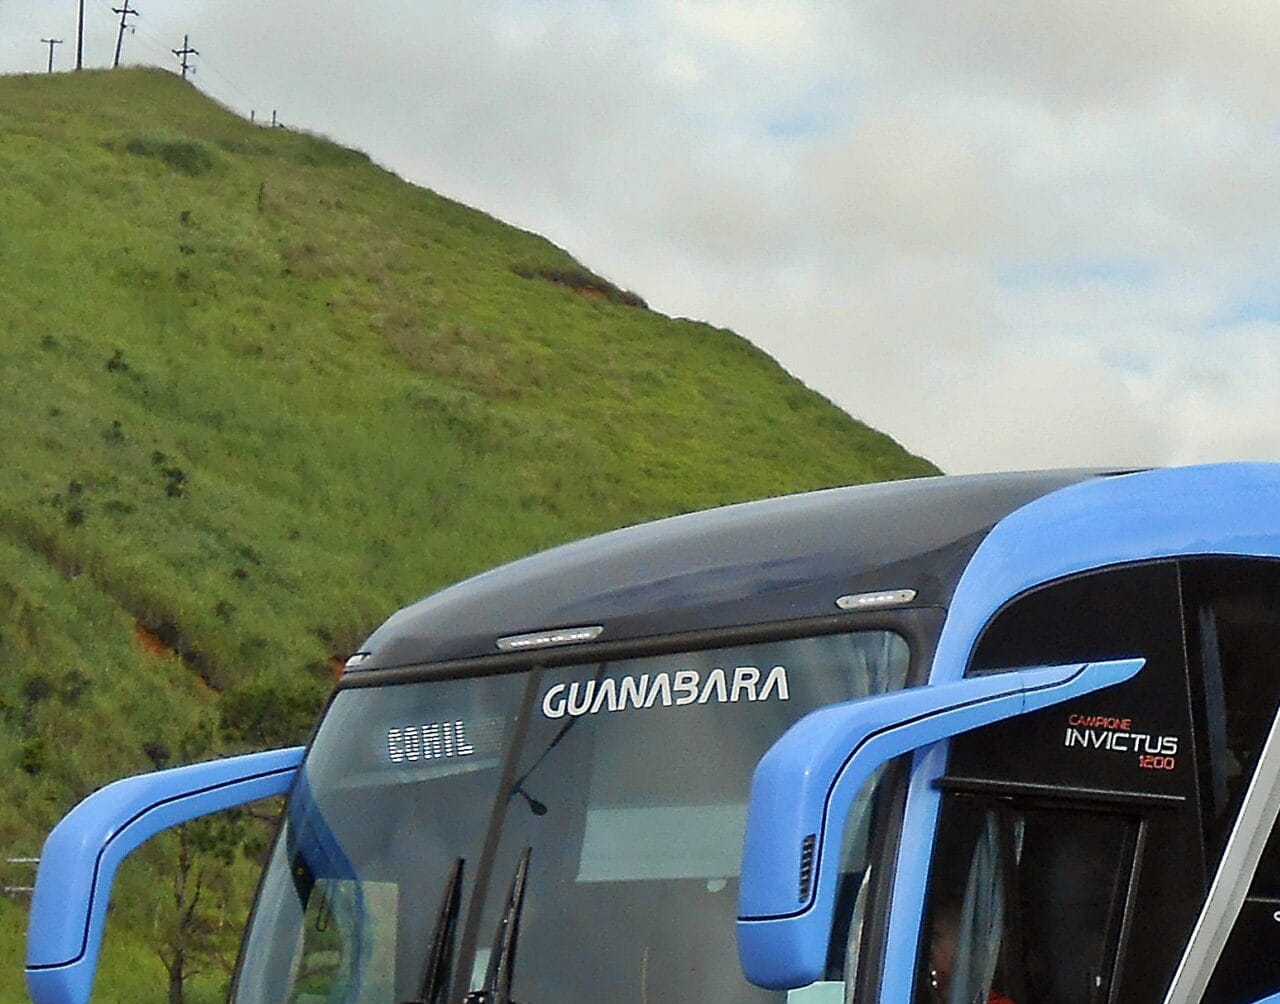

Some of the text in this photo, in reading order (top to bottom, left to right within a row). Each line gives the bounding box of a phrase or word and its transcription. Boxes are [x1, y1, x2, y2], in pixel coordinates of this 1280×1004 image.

[543, 666, 789, 719] GUANABARA
[1069, 714, 1132, 731] CAMPIONE
[388, 720, 474, 763] COMIL
[1064, 727, 1178, 755] INVICTUS
[1138, 755, 1176, 770] 1200
